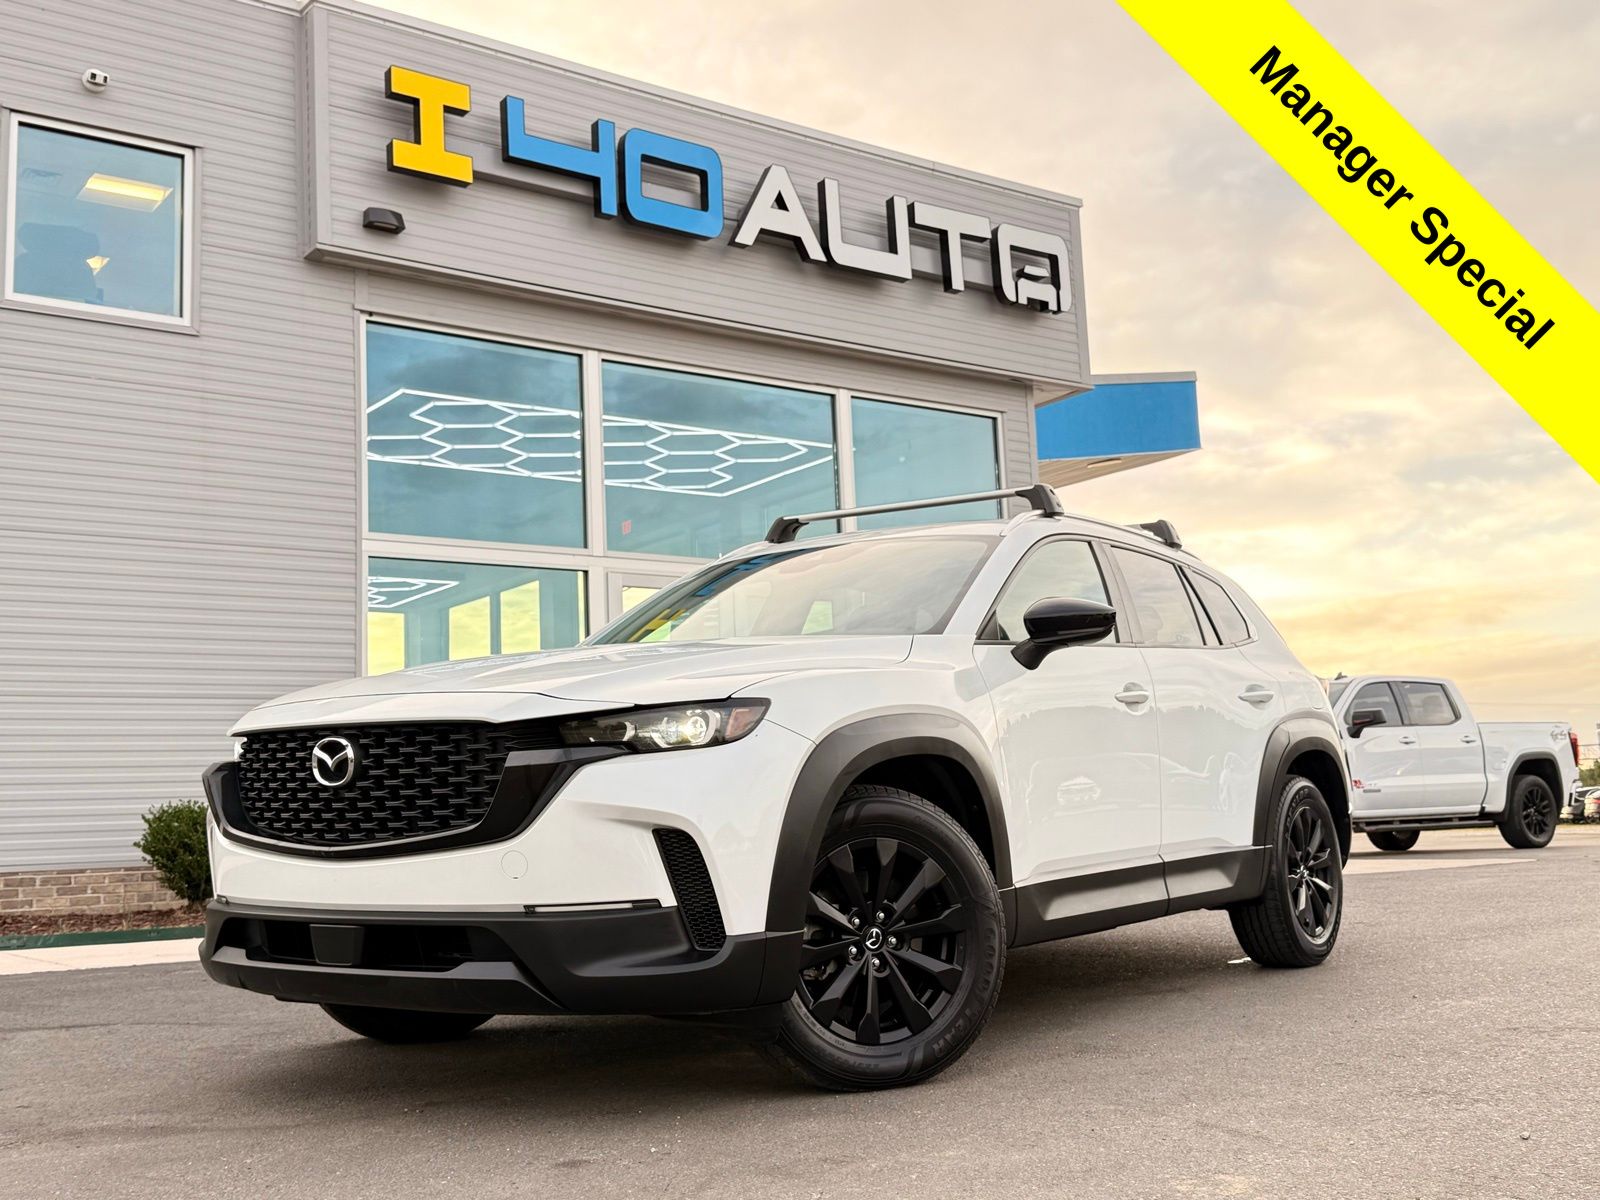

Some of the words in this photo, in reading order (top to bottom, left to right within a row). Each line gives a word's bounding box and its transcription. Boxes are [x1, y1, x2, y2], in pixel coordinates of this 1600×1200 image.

[385, 64, 474, 187] I
[501, 95, 724, 242] 40
[731, 163, 1072, 315] AUTO
